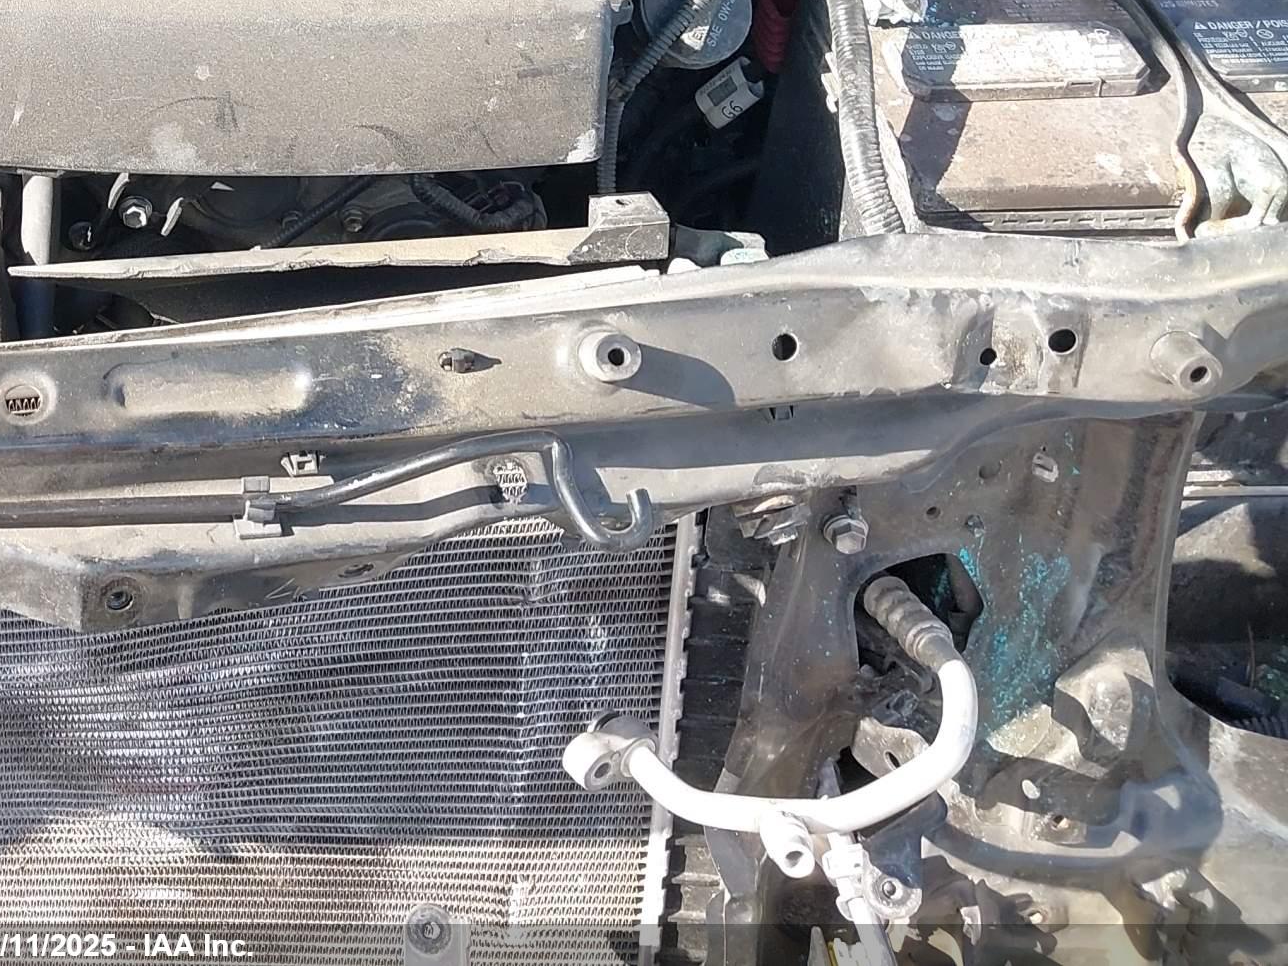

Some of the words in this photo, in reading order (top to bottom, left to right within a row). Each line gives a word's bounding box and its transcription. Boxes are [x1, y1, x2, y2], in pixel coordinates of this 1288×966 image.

[1207, 20, 1254, 30] DANGER
[706, 23, 723, 48] SAE
[921, 29, 967, 40] DANGE
[721, 99, 744, 120] G6
